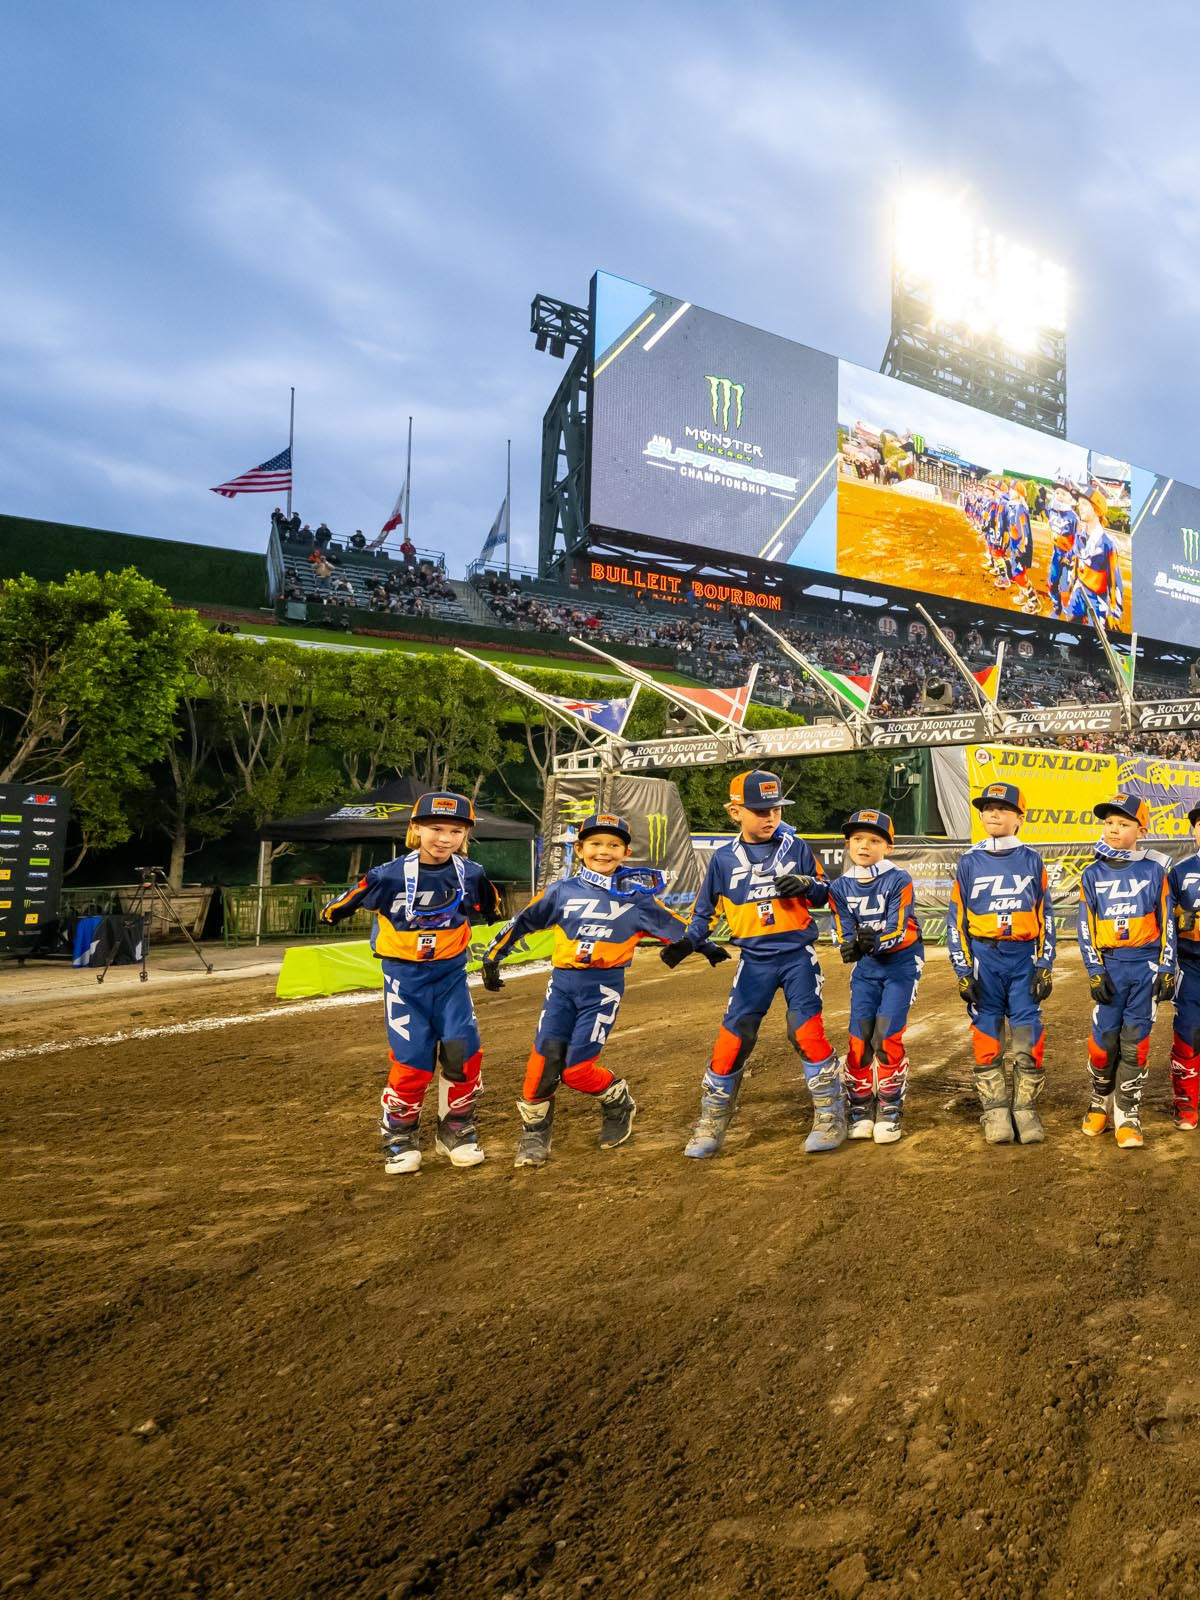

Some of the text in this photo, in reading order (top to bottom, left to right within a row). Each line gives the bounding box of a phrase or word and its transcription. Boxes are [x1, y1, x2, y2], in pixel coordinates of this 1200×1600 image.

[652, 435, 672, 448] AMA
[685, 426, 763, 457] MONSTER
[697, 443, 753, 462] ENERGY
[680, 467, 767, 496] CHAMPIONSHIP
[591, 562, 681, 593] BULLEIT
[692, 581, 781, 611] BOURBON
[1020, 710, 1112, 721] ROCKY MOUNTAIN
[1157, 704, 1191, 714] ROCKY
[887, 719, 976, 732] ROCKY MOUNTAIN
[761, 729, 846, 743] ROCKY MOUNTAIN
[636, 742, 719, 756] ROCKY MOUNTAIN
[999, 752, 1111, 773] DUNLOP
[997, 768, 1102, 783] MOTORCYCLE TIRES
[1095, 840, 1131, 859] 100%
[729, 861, 797, 889] FLY
[909, 862, 958, 871] MONSTER
[970, 875, 1034, 899] FLY
[1095, 880, 1150, 899] FLY
[563, 899, 636, 920] FLY
[846, 891, 889, 916] FLY
[988, 898, 1022, 911] KTM
[1104, 903, 1137, 916] KTM
[577, 924, 614, 939] KTM
